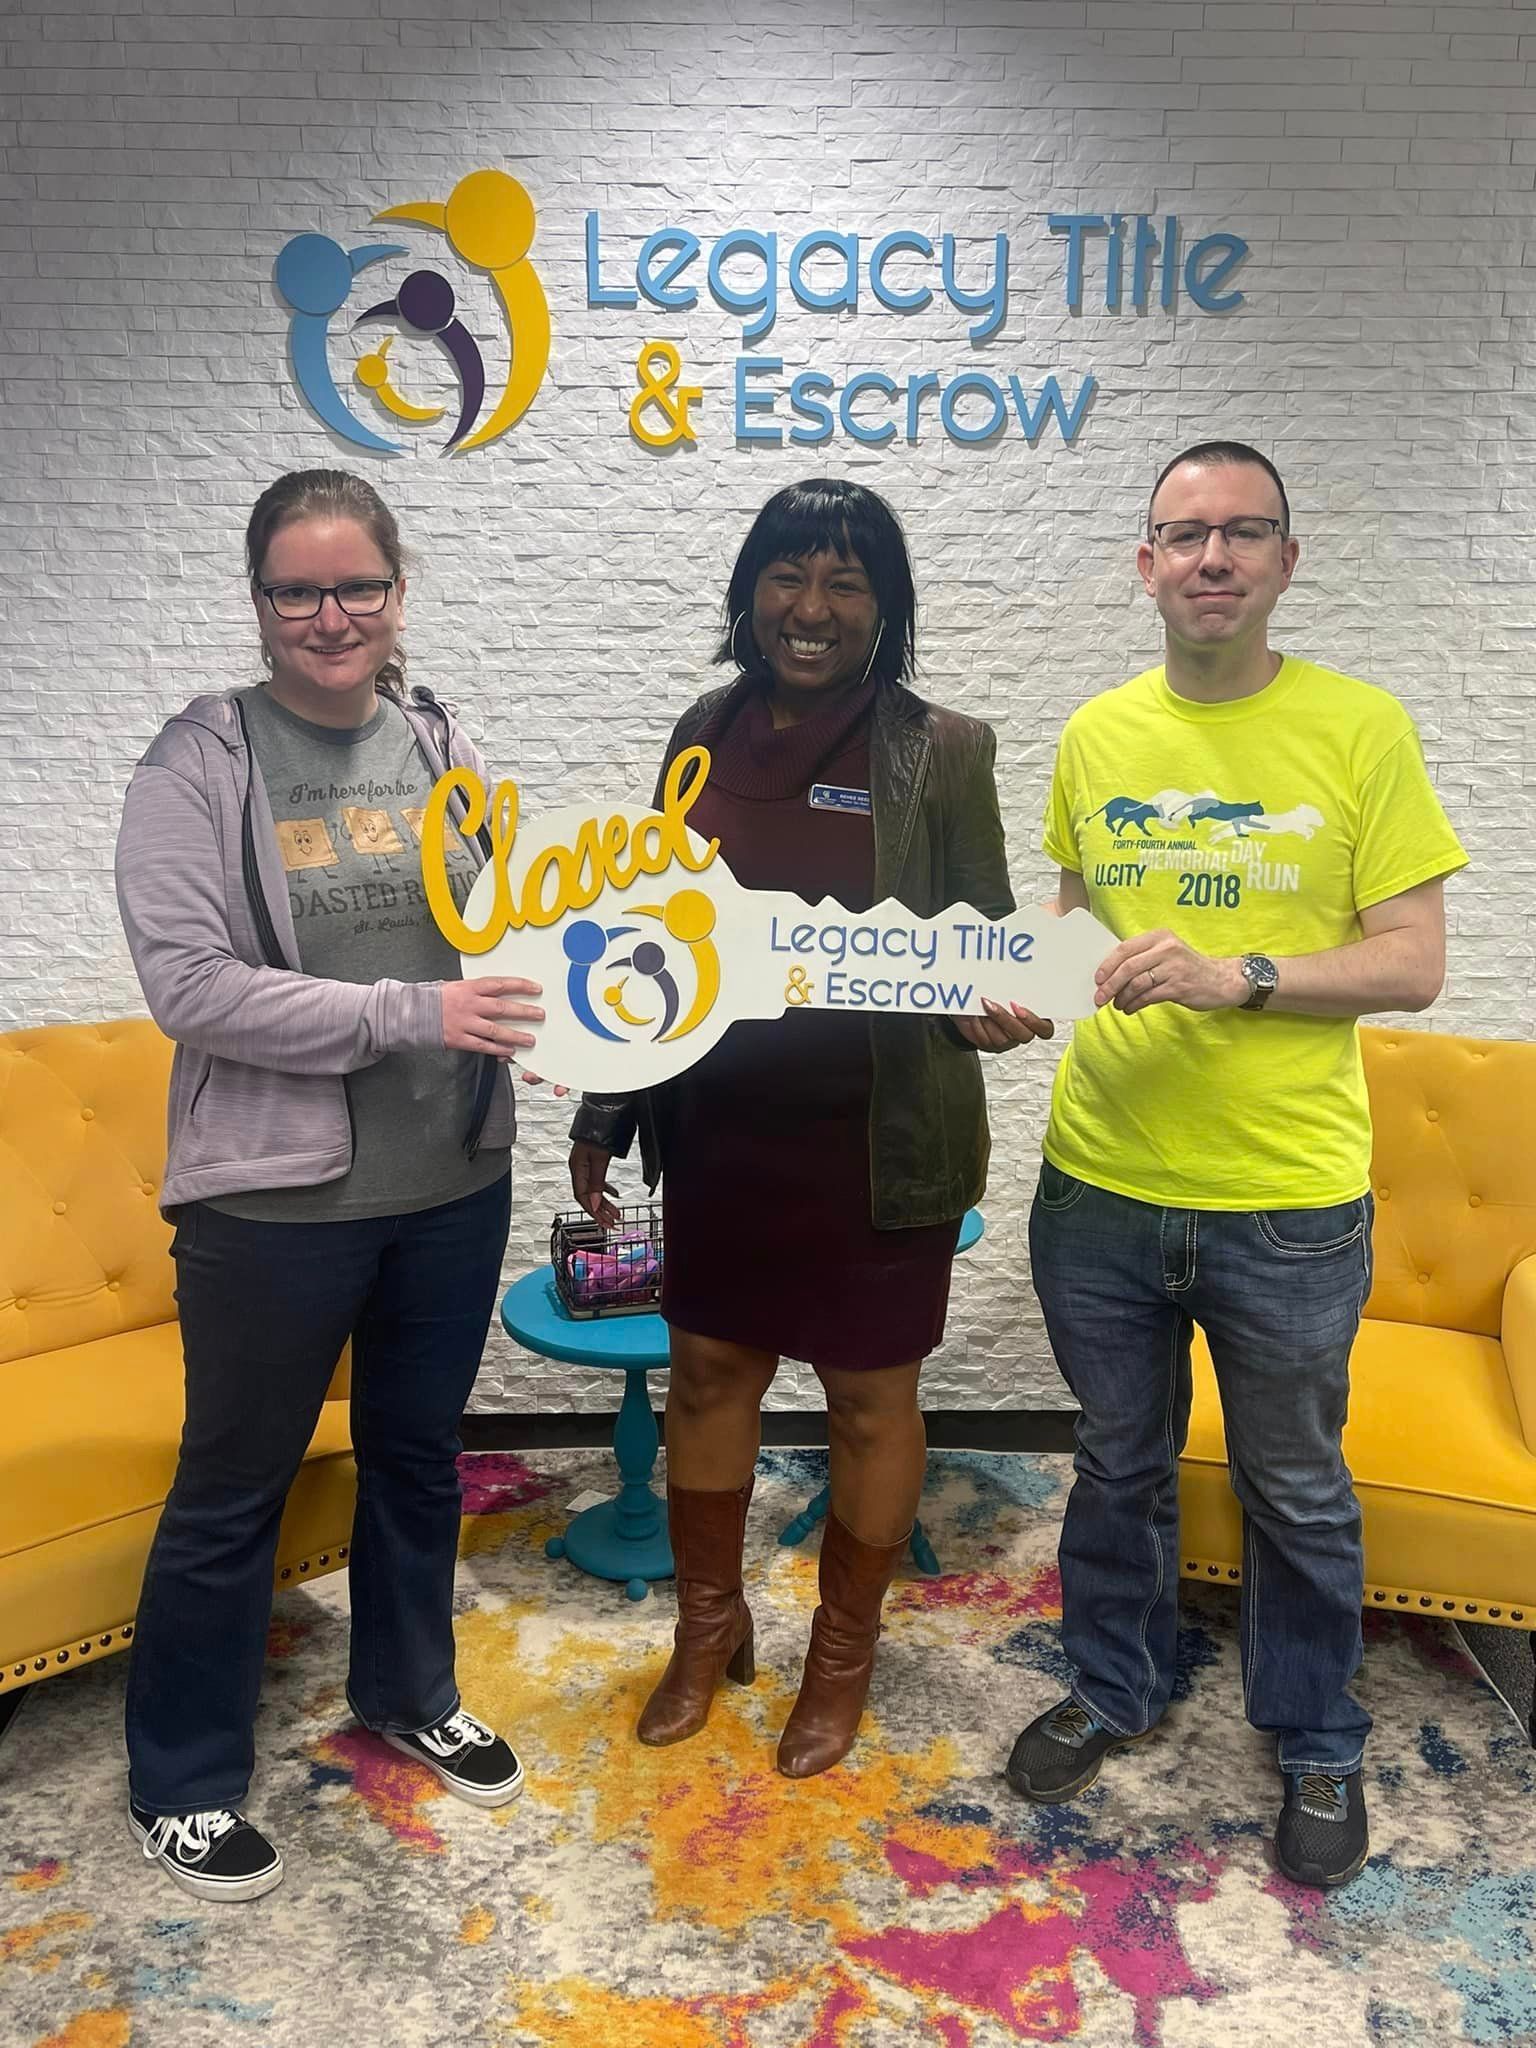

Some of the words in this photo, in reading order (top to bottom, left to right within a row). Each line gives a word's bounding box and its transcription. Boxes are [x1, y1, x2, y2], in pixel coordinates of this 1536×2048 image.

[587, 210, 1007, 347] Legacy
[1049, 212, 1249, 314] Title
[629, 341, 702, 448] &
[735, 356, 1098, 448] Escrow
[289, 782, 327, 804] I'm
[328, 783, 365, 799] here
[366, 780, 395, 803] for
[421, 746, 720, 954] Closed
[1112, 839, 1166, 850] FORTY-FOURTH
[1167, 840, 1198, 851] ANNUAL
[1138, 849, 1231, 873] MEMORIAL
[1230, 840, 1268, 864] DAY
[1095, 863, 1147, 887] U.CITY
[1176, 872, 1241, 909] 2018
[1246, 863, 1300, 892] RUN
[771, 916, 937, 969] Legacy
[953, 923, 1035, 962] Title
[784, 964, 815, 1006] &
[826, 971, 973, 1010] Escrow
